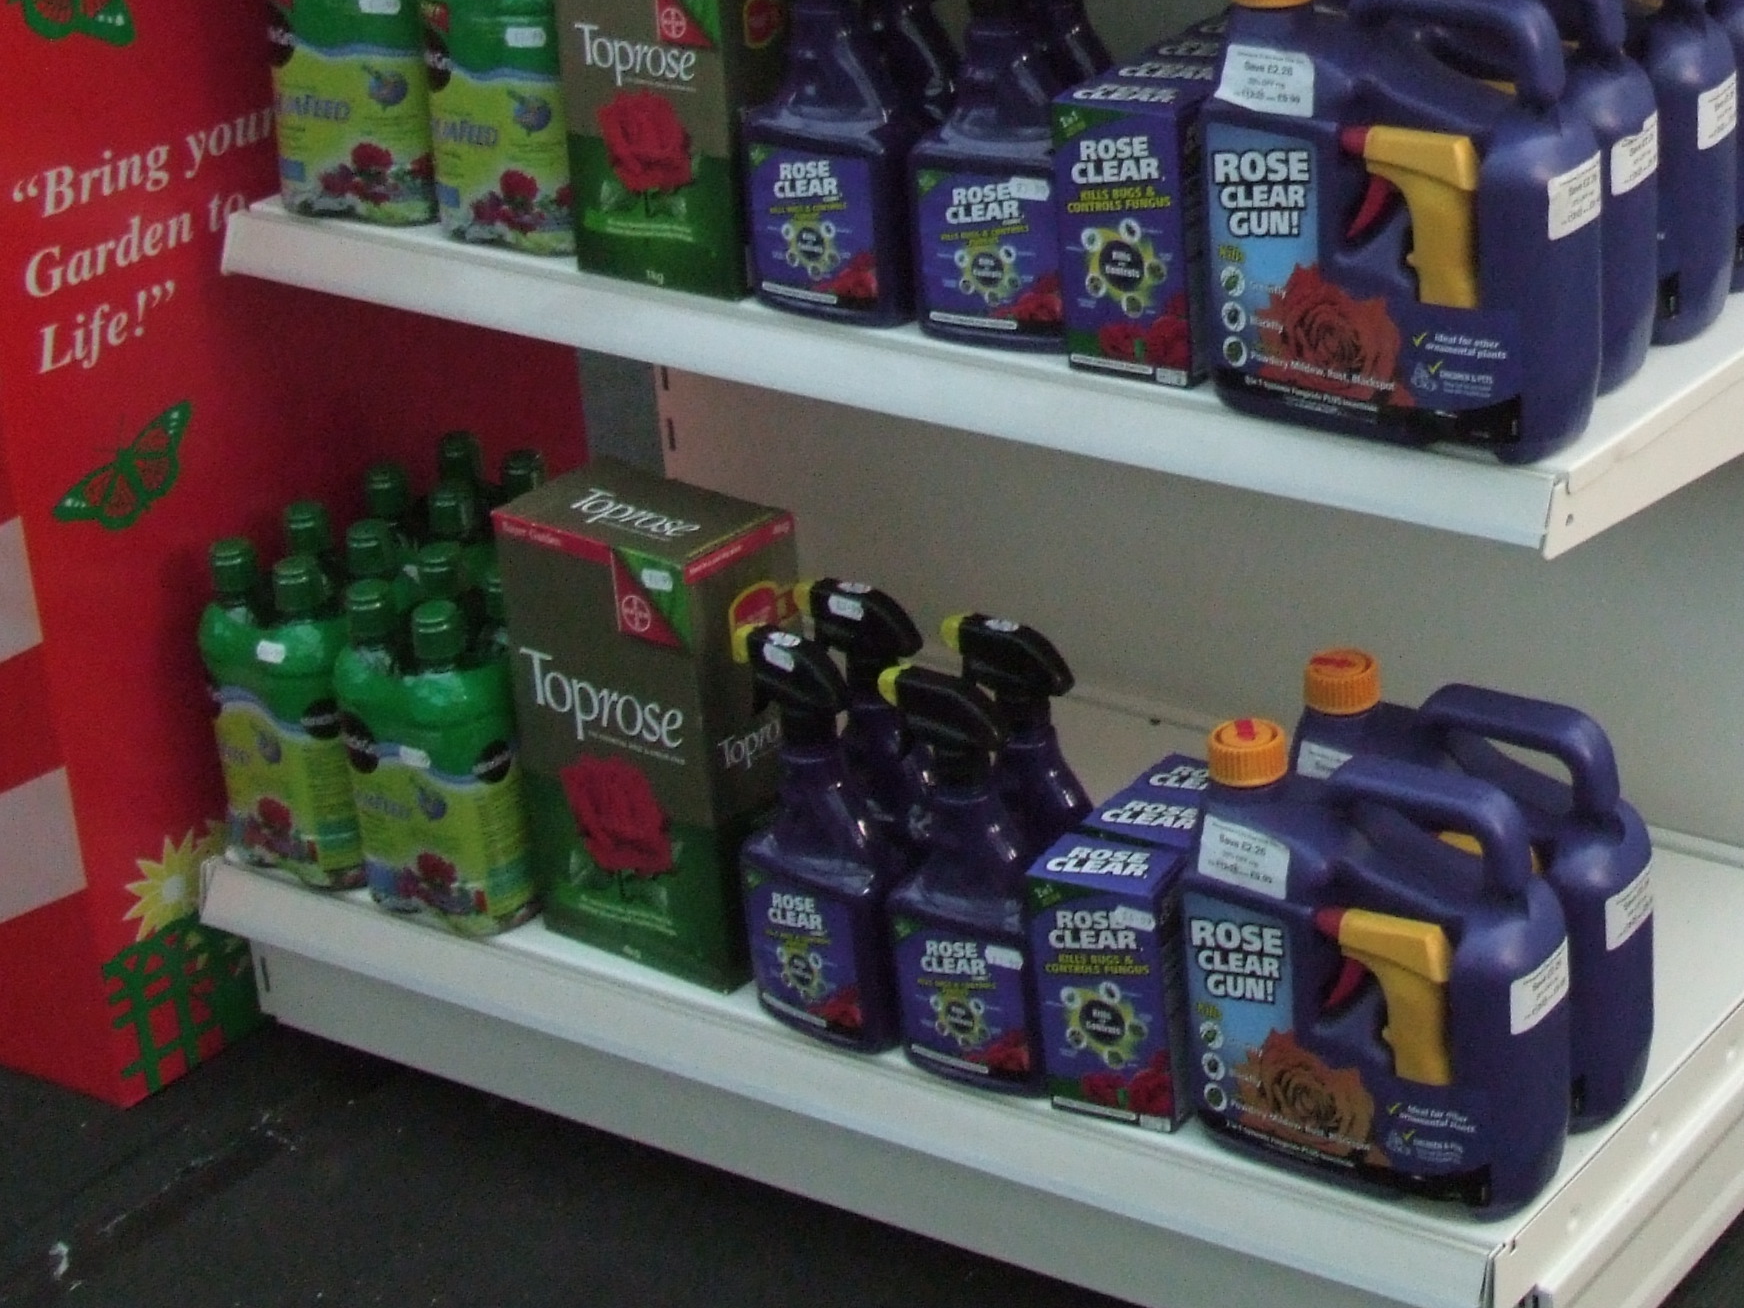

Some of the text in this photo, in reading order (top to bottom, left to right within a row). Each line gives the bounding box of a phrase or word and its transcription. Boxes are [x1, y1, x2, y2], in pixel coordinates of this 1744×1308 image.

[575, 23, 696, 87] Toprose
[185, 110, 277, 174] your
[1079, 136, 1149, 161] ROSE
[779, 160, 831, 180] ROSE
[1071, 157, 1160, 184] CLEAR
[1214, 151, 1310, 183] ROSE
[773, 177, 838, 199] CLEAR
[952, 183, 1011, 206] ROSE
[1112, 187, 1140, 199] BUGS
[1220, 184, 1305, 209] CLEAR
[946, 200, 1019, 225] CLEAR
[1067, 195, 1171, 213] CONTROLS FUNGUS
[1229, 210, 1300, 237] GUN!
[24, 209, 195, 300] Garden
[1458, 335, 1500, 349] for other
[1477, 348, 1507, 361] plants
[1352, 372, 1396, 392] Blackspot
[570, 488, 700, 537] Toprose
[520, 646, 683, 748] Toprose
[718, 721, 782, 770] Topro
[1101, 808, 1197, 830] CLEAR
[1122, 800, 1199, 816] ROSE
[1067, 845, 1150, 865] ROSE
[1046, 856, 1149, 878] CLEAR
[772, 891, 816, 914] ROSE
[768, 907, 823, 931] CLEAR
[1056, 910, 1124, 930] ROSE
[1048, 928, 1137, 950] CLEAR
[1191, 919, 1283, 956] ROSE
[925, 940, 978, 959] ROSE
[920, 956, 987, 976] CLEAR
[1198, 949, 1280, 978] CLEAR
[1207, 974, 1275, 1002] GUN!
